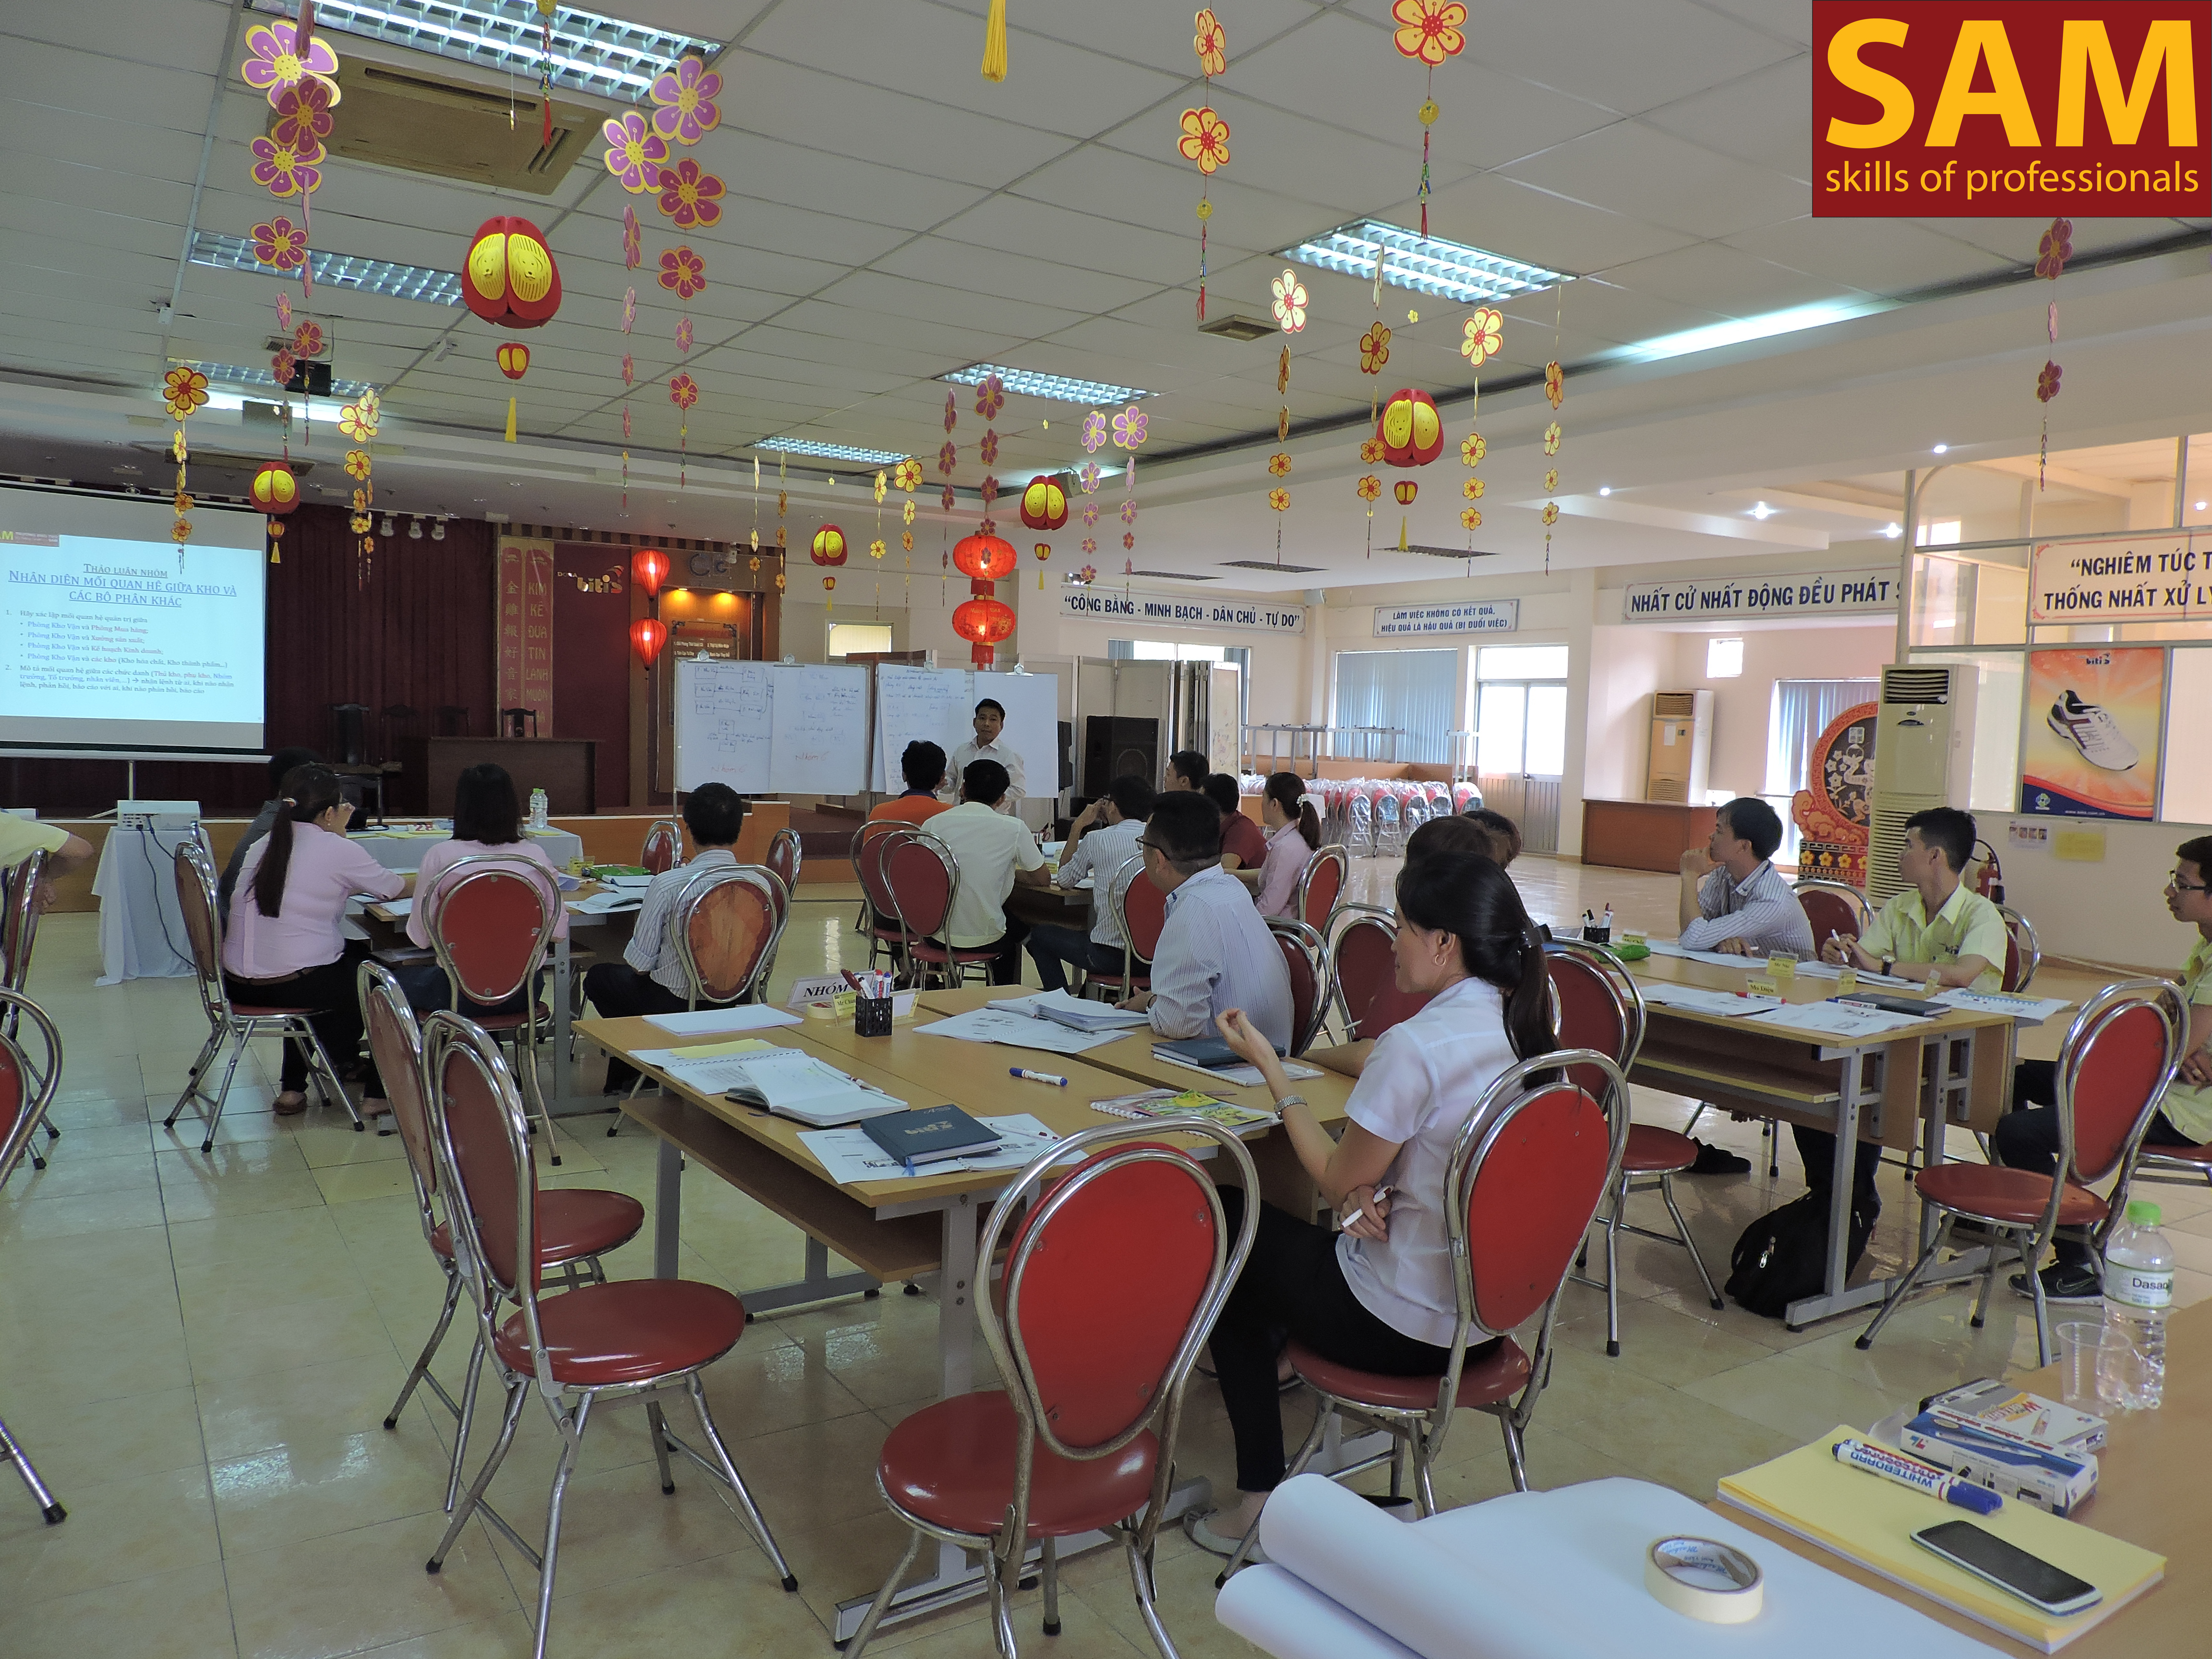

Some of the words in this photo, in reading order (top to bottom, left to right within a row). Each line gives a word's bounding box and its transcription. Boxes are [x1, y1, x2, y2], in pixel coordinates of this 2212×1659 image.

[2158, 548, 2196, 572] TÚC
[110, 579, 143, 589] QUAN
[197, 585, 220, 594] KHO
[223, 585, 237, 595] VÀ
[1632, 587, 1670, 613] NHẤT
[1675, 585, 1696, 610] CỬ
[1700, 582, 1742, 609] NHẤT
[1748, 583, 1793, 611] ĐỘNG
[1799, 577, 1835, 605] ĐỀU
[1841, 577, 1889, 602] PHÁT
[2044, 584, 2102, 610] THỐNG
[2108, 581, 2157, 608] NHẤT
[2164, 580, 2191, 606] XỬ
[69, 590, 92, 600] CÁC
[151, 596, 182, 606] KHÁC
[1145, 603, 1171, 617] MINH
[1175, 605, 1202, 622] BẠCH
[1213, 605, 1233, 622] DÂN
[1236, 607, 1256, 624] CHỦ
[1266, 611, 1279, 628] TỰ
[1393, 610, 1407, 620] LÀM
[1409, 609, 1424, 620] VIỆC
[1452, 607, 1461, 616] CÓ
[1464, 605, 1476, 616] KẾT
[1381, 623, 1395, 633] HIỆU
[1398, 621, 1411, 632] QUẢ
[1413, 622, 1421, 631] LÀ
[1423, 622, 1437, 632] HẬU
[1440, 620, 1453, 630] QUẢ
[529, 647, 546, 660] TIN
[803, 982, 849, 997] NHÓM
[1851, 1452, 1933, 1488] WHITEBOARD
